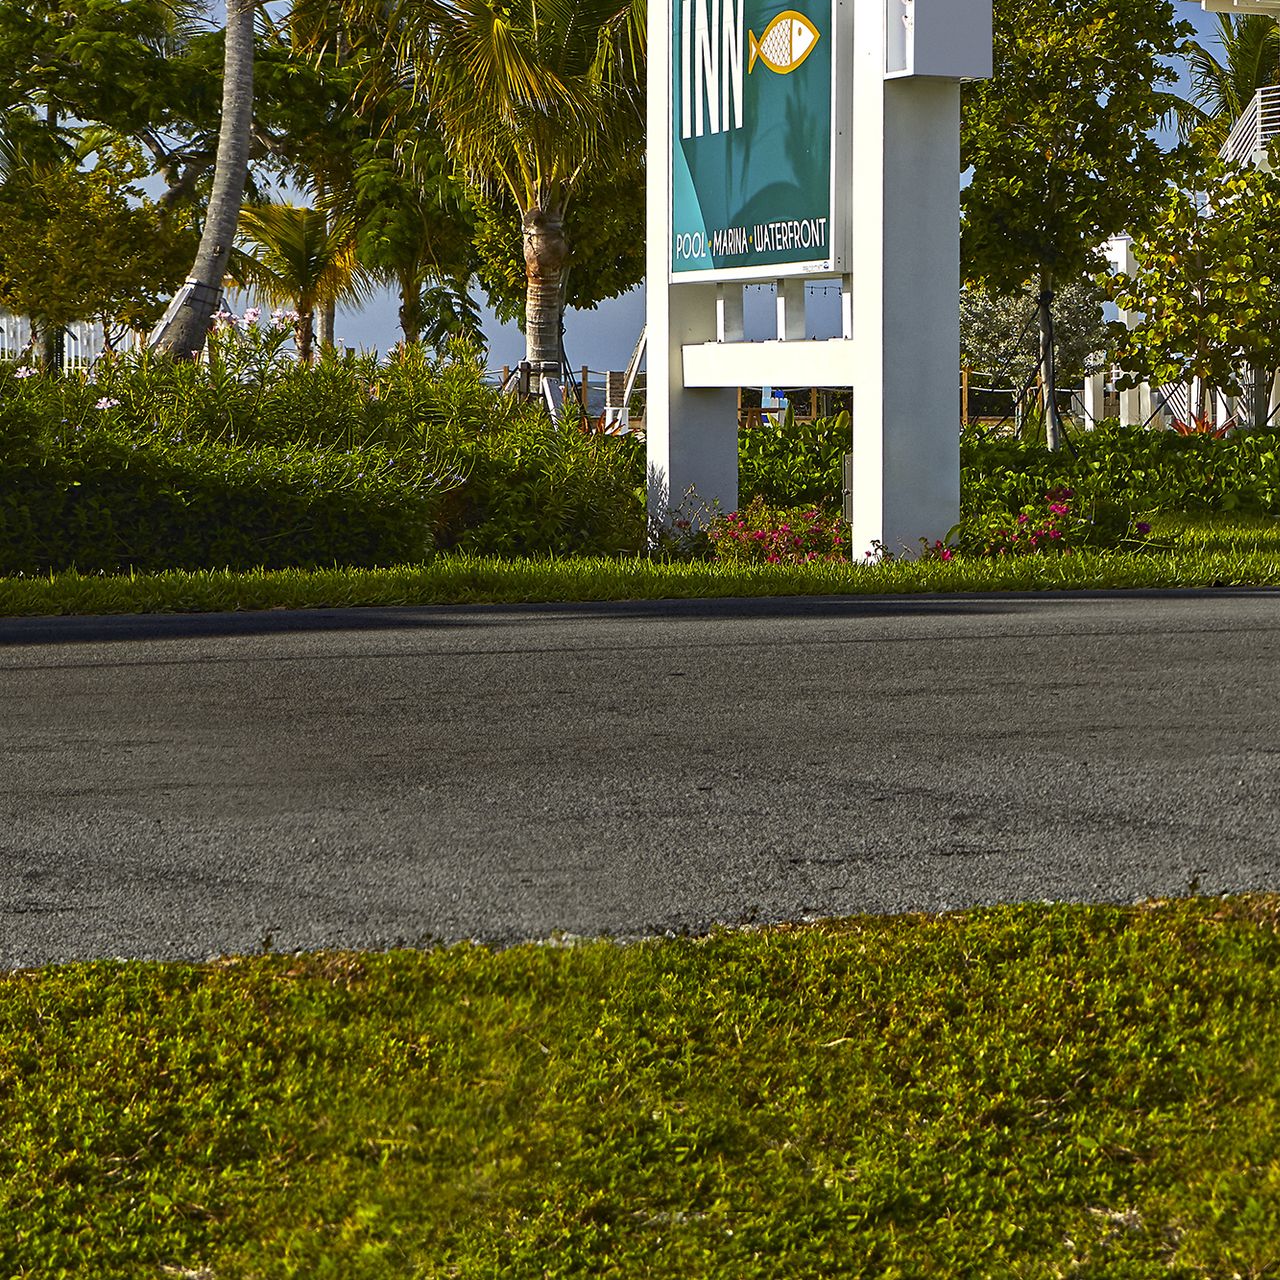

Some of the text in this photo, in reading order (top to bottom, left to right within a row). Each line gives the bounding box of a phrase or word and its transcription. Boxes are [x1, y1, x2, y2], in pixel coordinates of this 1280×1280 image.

[676, 218, 826, 259] POOL MARINA WATERFRONT
